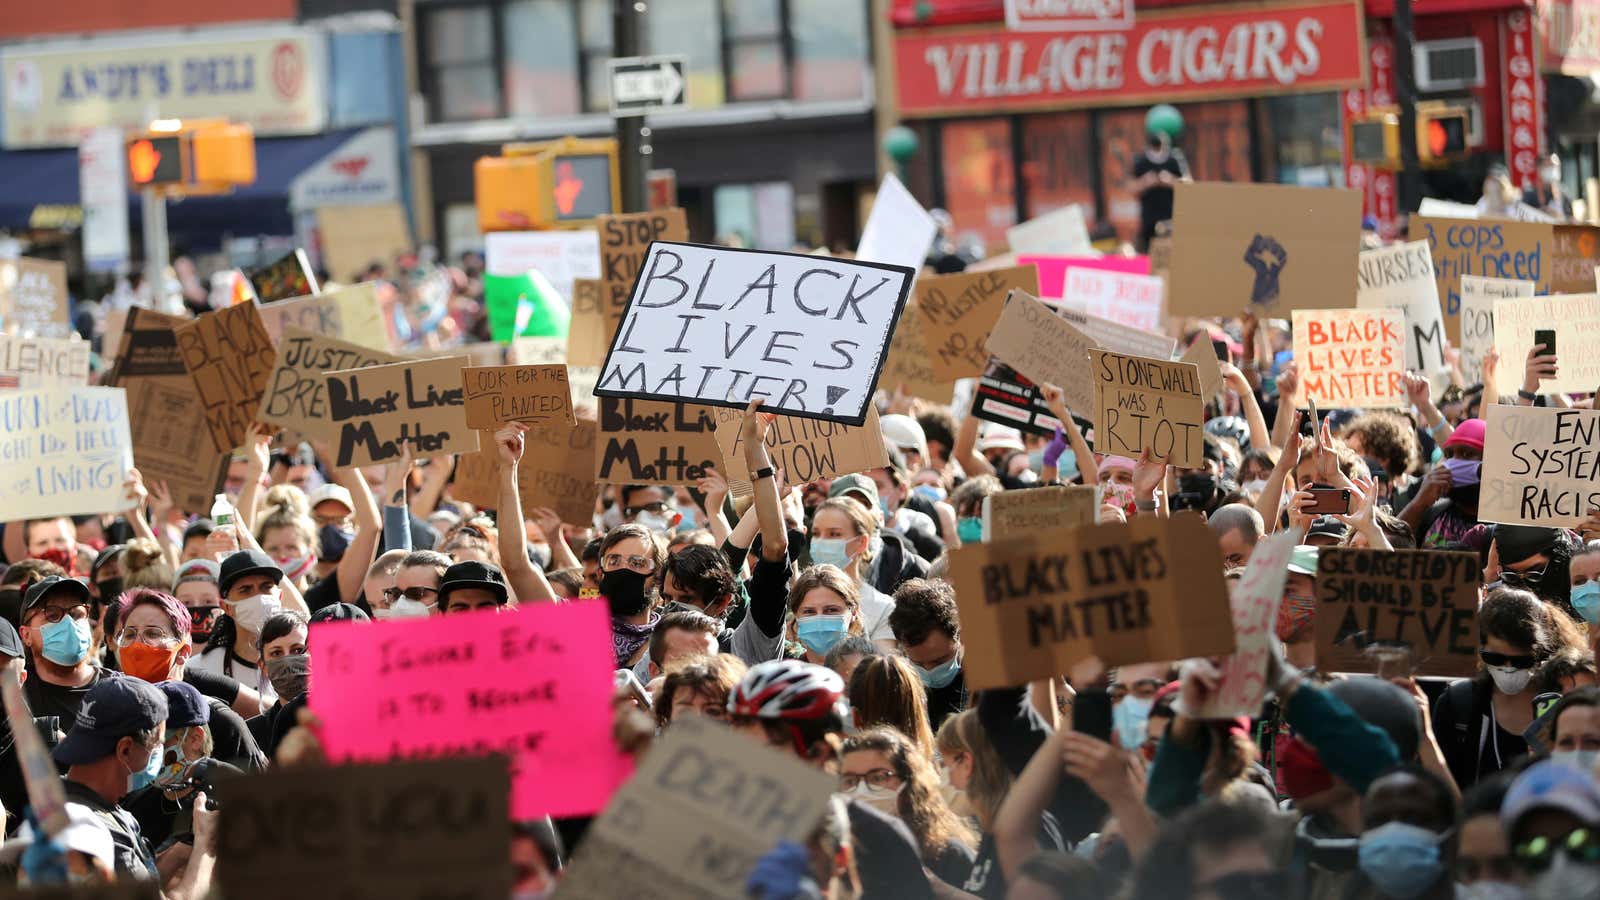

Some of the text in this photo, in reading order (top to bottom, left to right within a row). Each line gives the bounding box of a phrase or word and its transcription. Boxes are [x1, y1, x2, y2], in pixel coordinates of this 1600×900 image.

[59, 55, 254, 101] ANDY'S DELI
[925, 18, 1323, 98] VILLAGE CIGARS
[605, 217, 667, 246] STOP
[1357, 247, 1430, 291] NURSES
[1482, 241, 1541, 281] need
[635, 249, 891, 325] BLACK
[920, 270, 1007, 326] NO JUSTICE
[180, 306, 271, 371] BLACK
[613, 311, 860, 371] LIVES
[938, 332, 967, 366] NO
[1308, 319, 1398, 346] BLACK
[1100, 352, 1201, 396] STONEWALL
[1308, 347, 1393, 372] LIVES
[326, 375, 399, 421] Black
[464, 368, 565, 396] LOOK FOR THE
[1118, 390, 1165, 416] WAS A
[1304, 372, 1405, 401] MATTER
[492, 392, 570, 422] PLANTED!
[601, 396, 670, 432] Black
[675, 402, 717, 432] Liv
[1553, 411, 1600, 446] EN
[336, 421, 450, 467] Matter
[1106, 408, 1200, 462] RIOT
[599, 438, 714, 481] Matter
[770, 438, 835, 485] NOW
[1520, 486, 1600, 520] RACIS
[981, 537, 1168, 606] BLACK LIVES
[1323, 578, 1456, 608] SHOULD BE
[1026, 588, 1152, 648] MATTER
[1333, 606, 1476, 655] ALIVE
